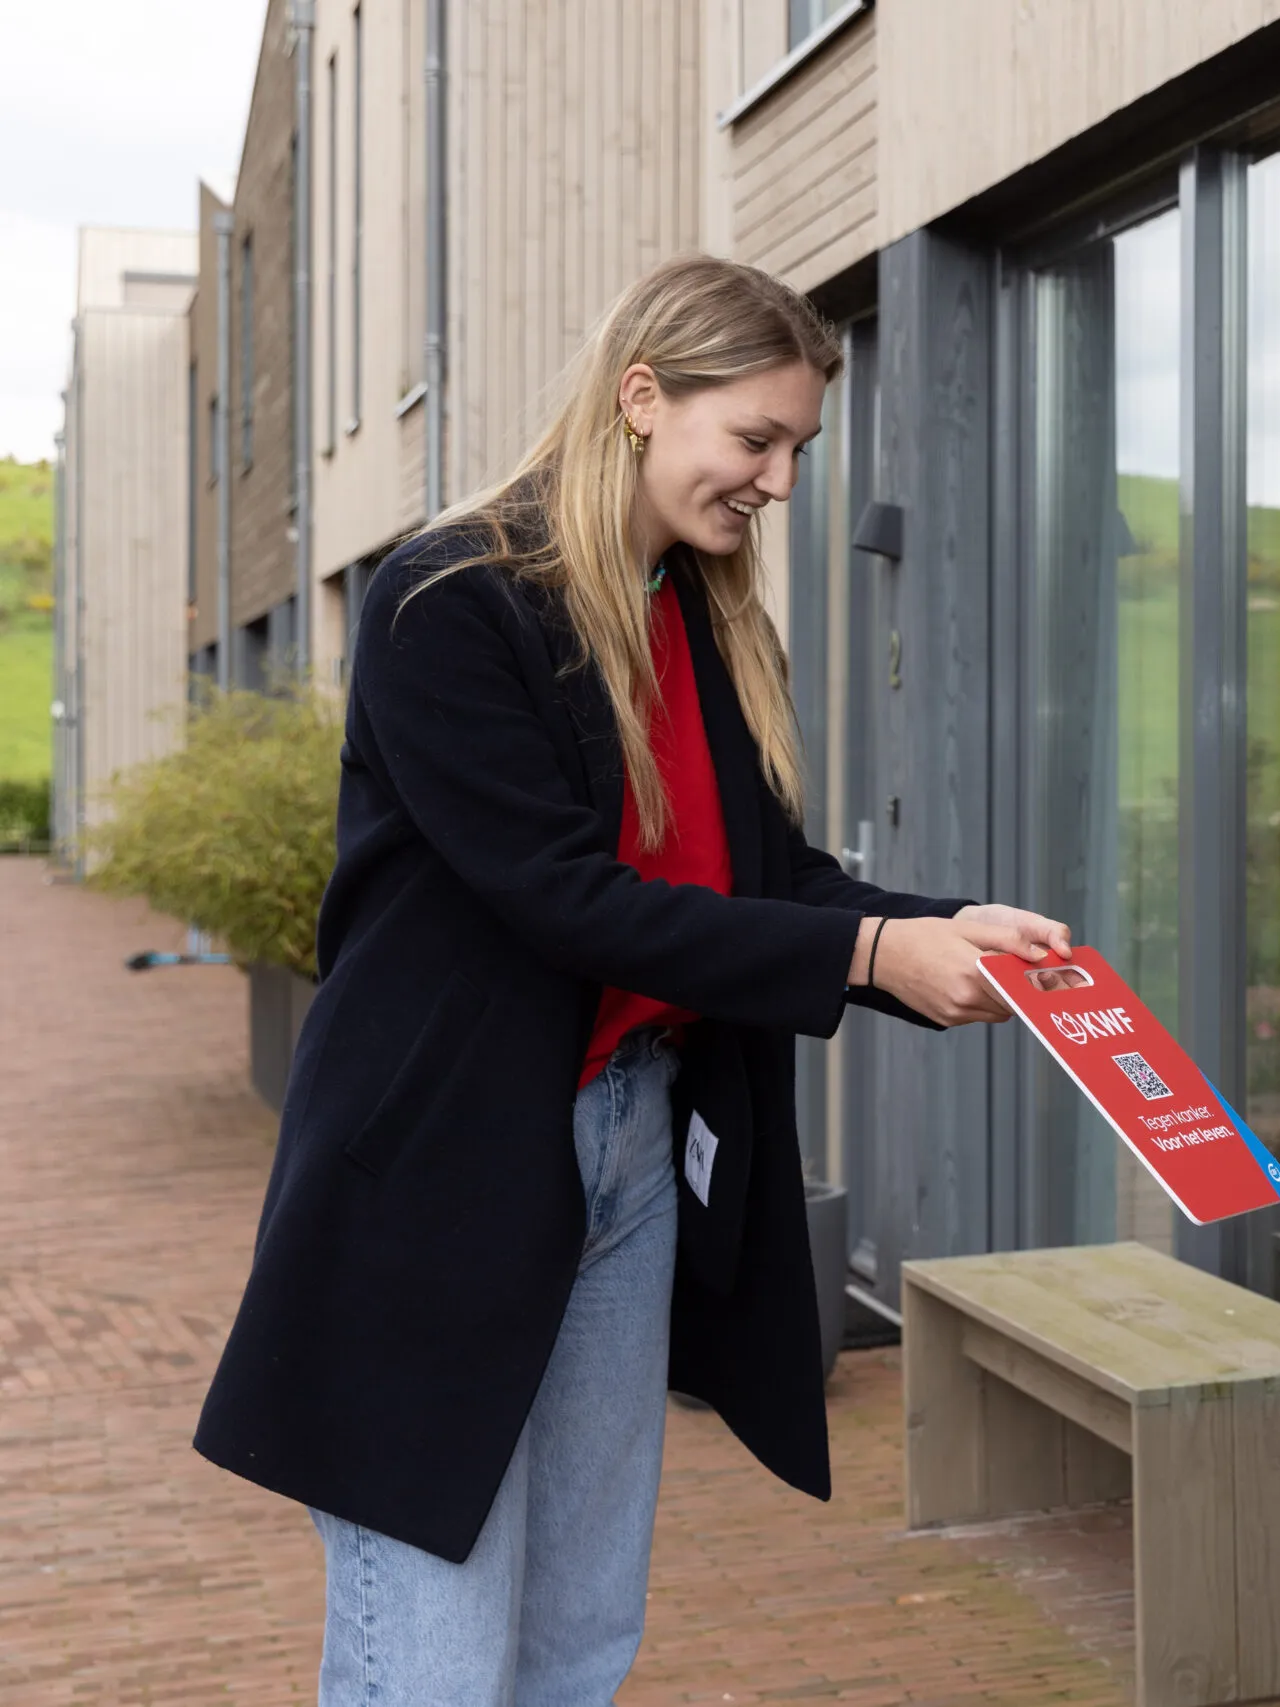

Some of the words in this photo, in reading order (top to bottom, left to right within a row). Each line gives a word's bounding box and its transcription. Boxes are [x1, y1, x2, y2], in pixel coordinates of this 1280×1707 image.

[1076, 1007, 1135, 1039] KWF
[1137, 1113, 1178, 1132] Tegen
[1171, 1105, 1215, 1124] kanker.
[1150, 1136, 1183, 1152] Voor
[1178, 1130, 1204, 1147] het
[1196, 1125, 1235, 1144] leven.
